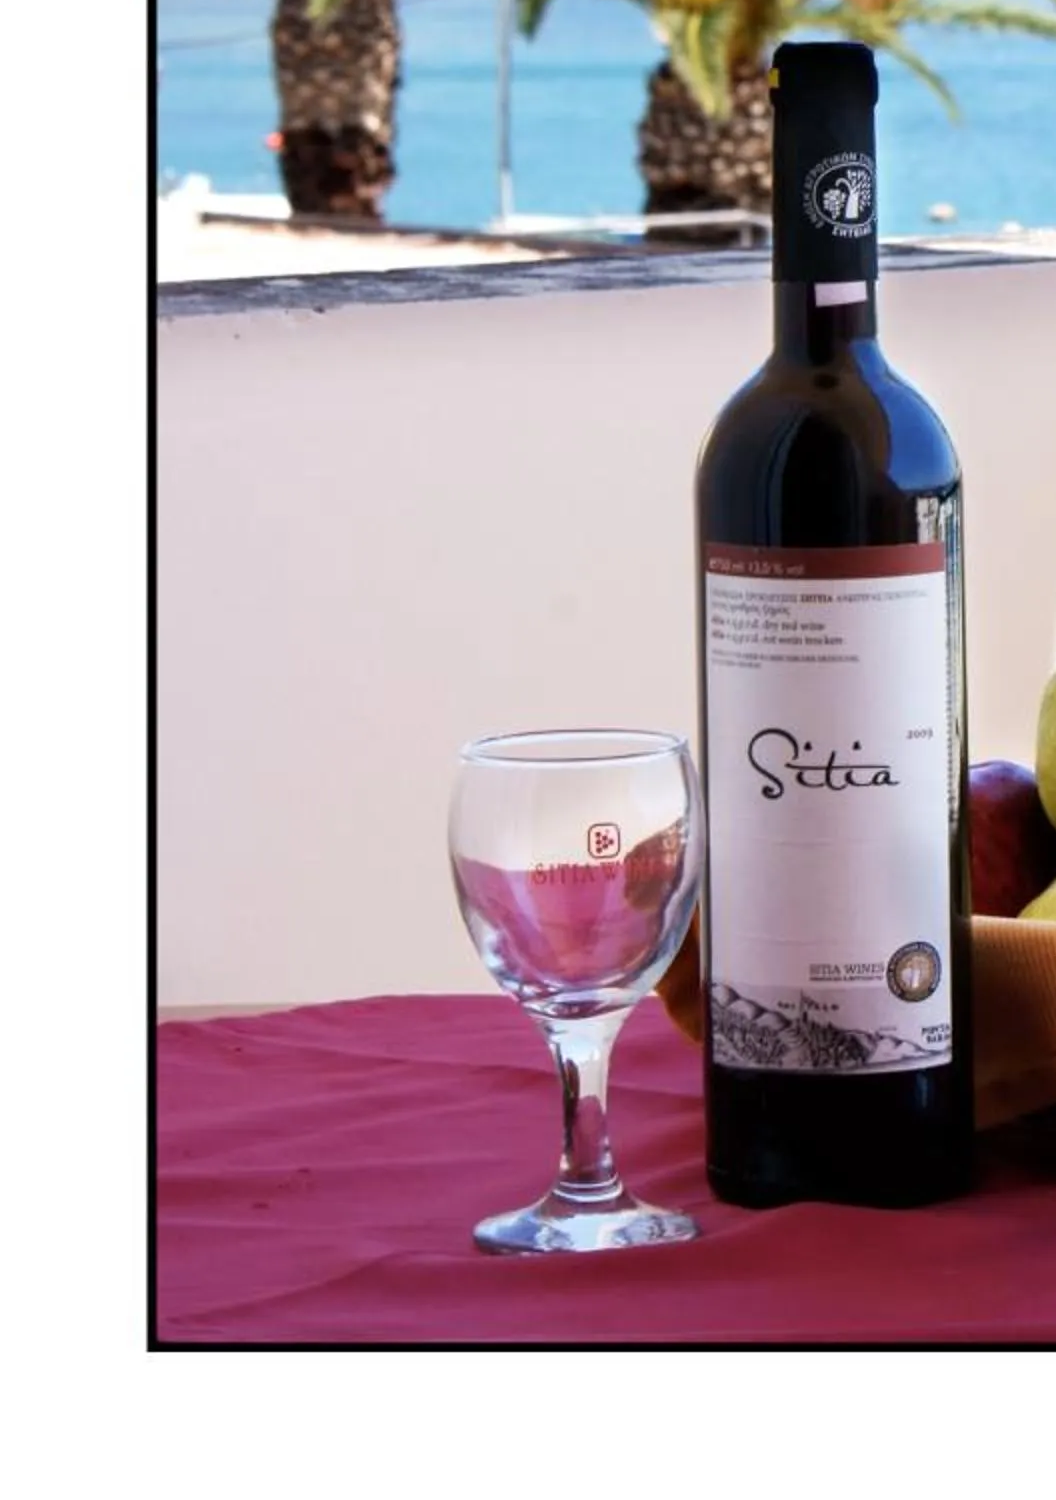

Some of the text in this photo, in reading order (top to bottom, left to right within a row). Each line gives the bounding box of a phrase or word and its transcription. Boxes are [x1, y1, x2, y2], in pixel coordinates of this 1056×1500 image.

[747, 728, 900, 800] Sitia
[532, 862, 596, 886] SITIA
[843, 961, 885, 975] WINES
